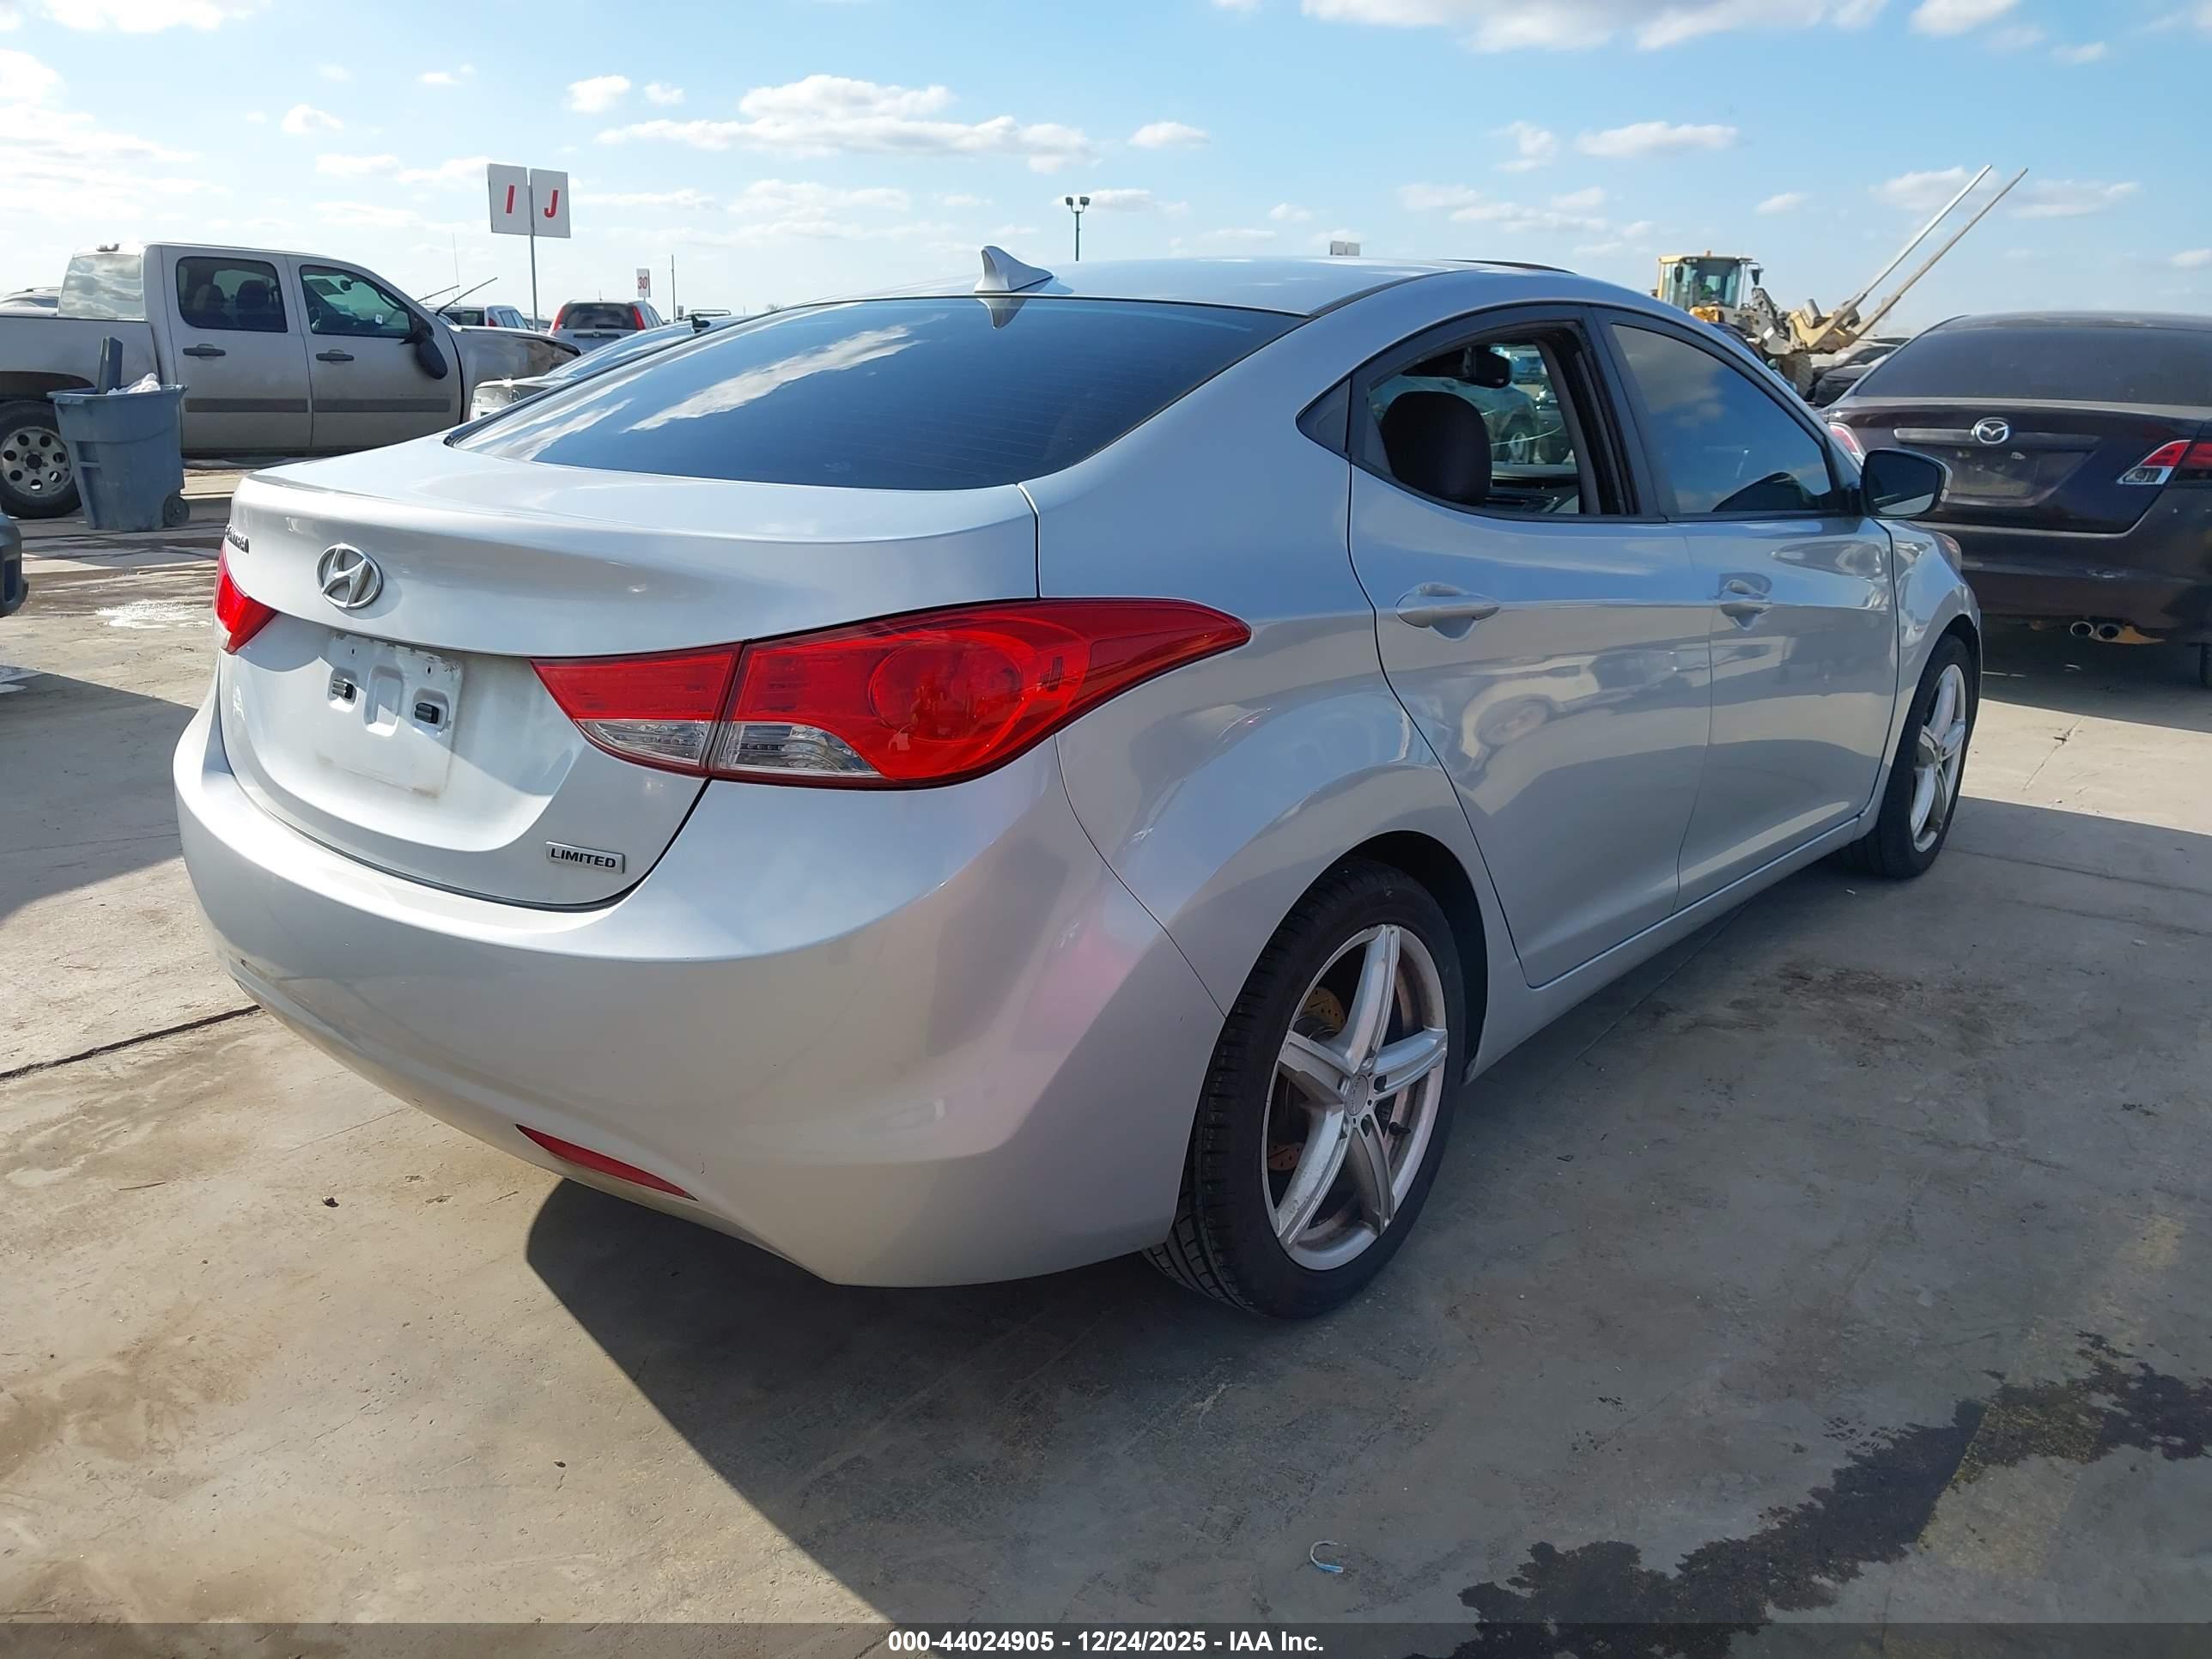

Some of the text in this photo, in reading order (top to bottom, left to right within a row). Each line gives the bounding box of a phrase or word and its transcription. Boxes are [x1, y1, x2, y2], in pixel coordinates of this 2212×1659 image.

[505, 185, 515, 214] I
[544, 189, 559, 218] J
[637, 276, 648, 290] 30
[550, 848, 617, 868] LIMITED
